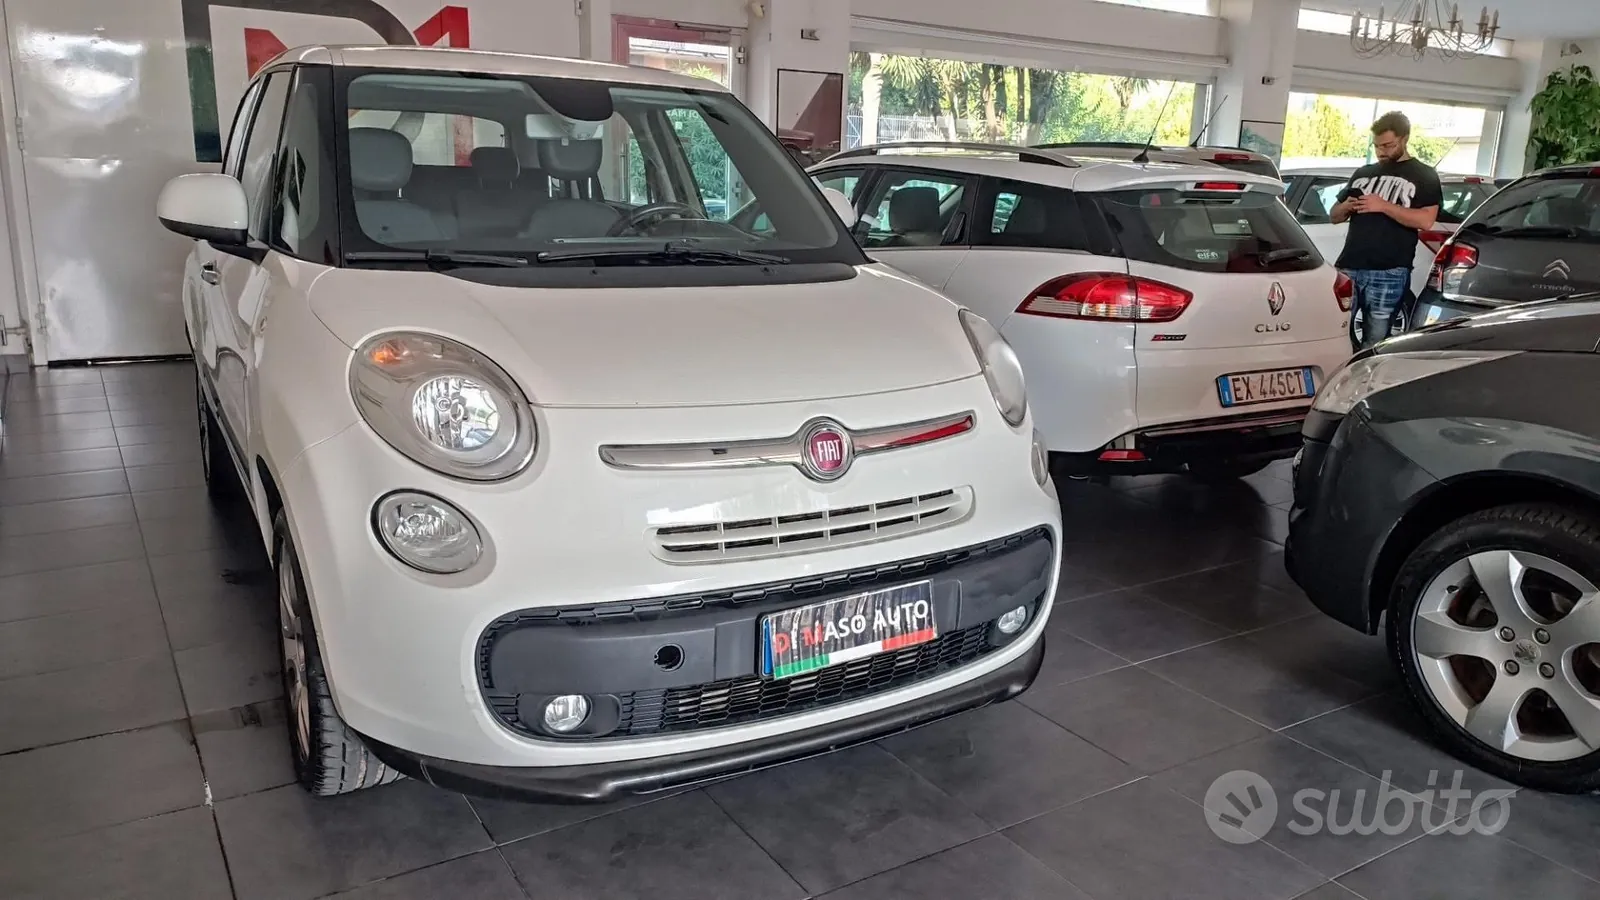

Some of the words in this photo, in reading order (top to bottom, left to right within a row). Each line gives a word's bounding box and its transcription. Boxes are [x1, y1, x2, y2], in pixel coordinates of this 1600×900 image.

[1254, 322, 1292, 333] CLIO
[1231, 376, 1254, 402] EX
[1259, 370, 1303, 399] 445CT
[816, 439, 841, 462] FIAT
[802, 614, 867, 647] MASO
[872, 600, 929, 632] AUTO
